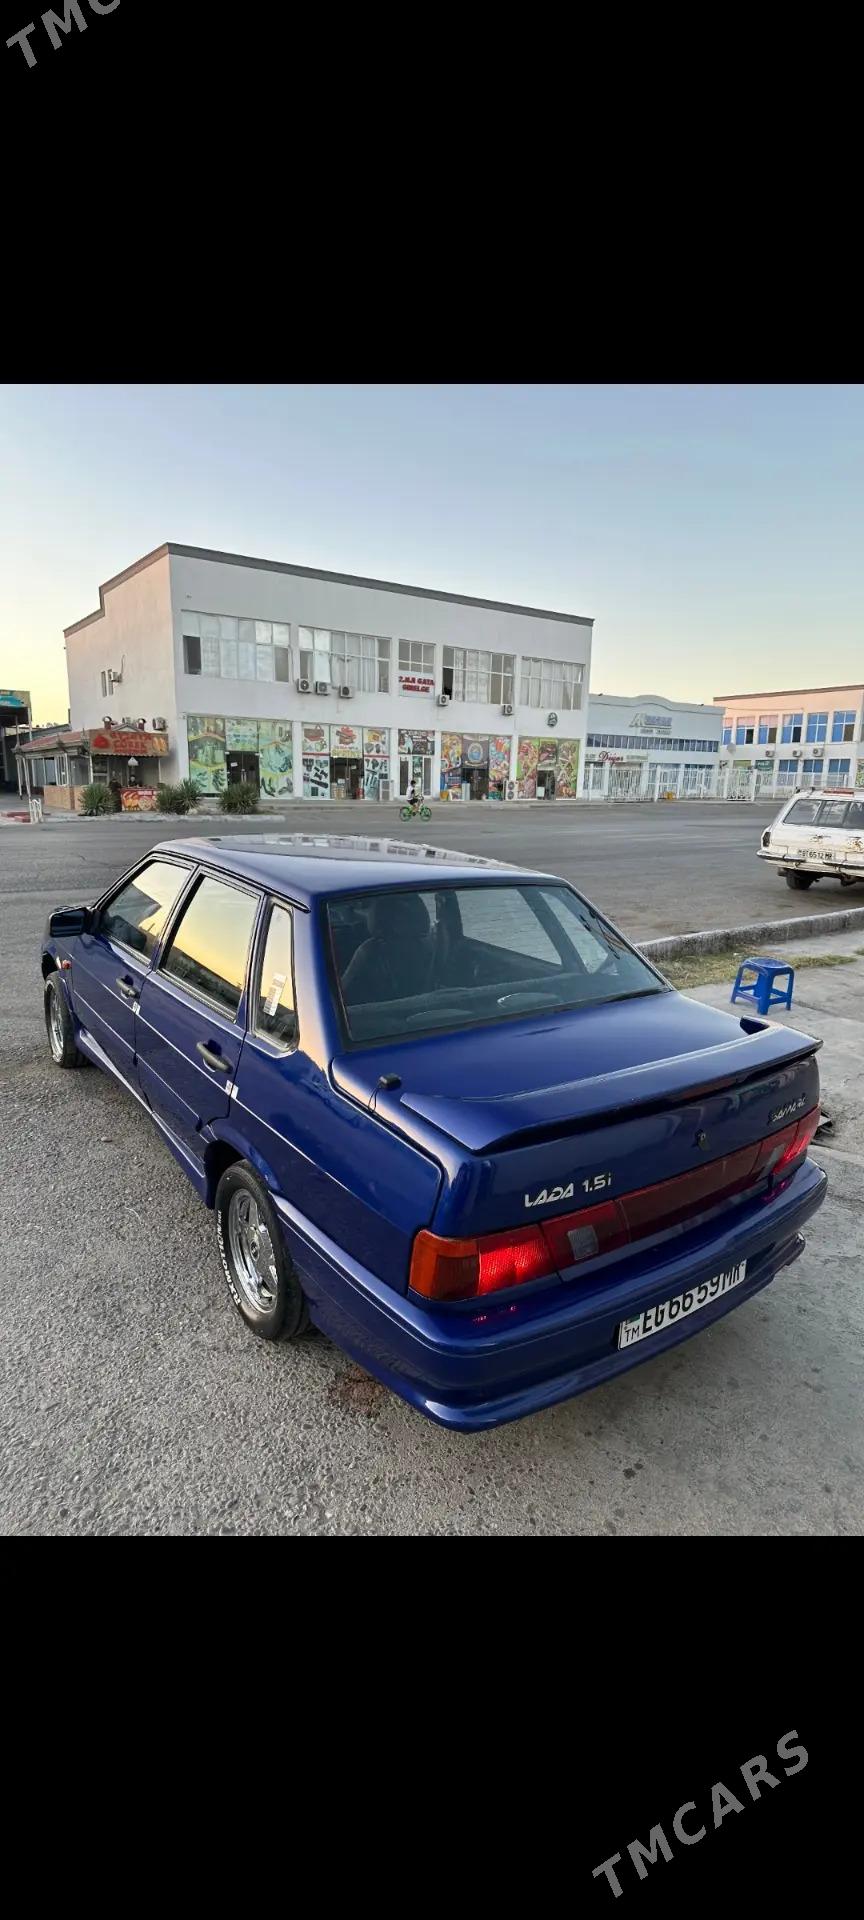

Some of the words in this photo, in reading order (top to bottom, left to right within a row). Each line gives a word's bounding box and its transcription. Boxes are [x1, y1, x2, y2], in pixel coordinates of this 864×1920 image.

[524, 1182, 574, 1207] LADA
[582, 1172, 612, 1192] 1.5i
[625, 1326, 640, 1342] TM
